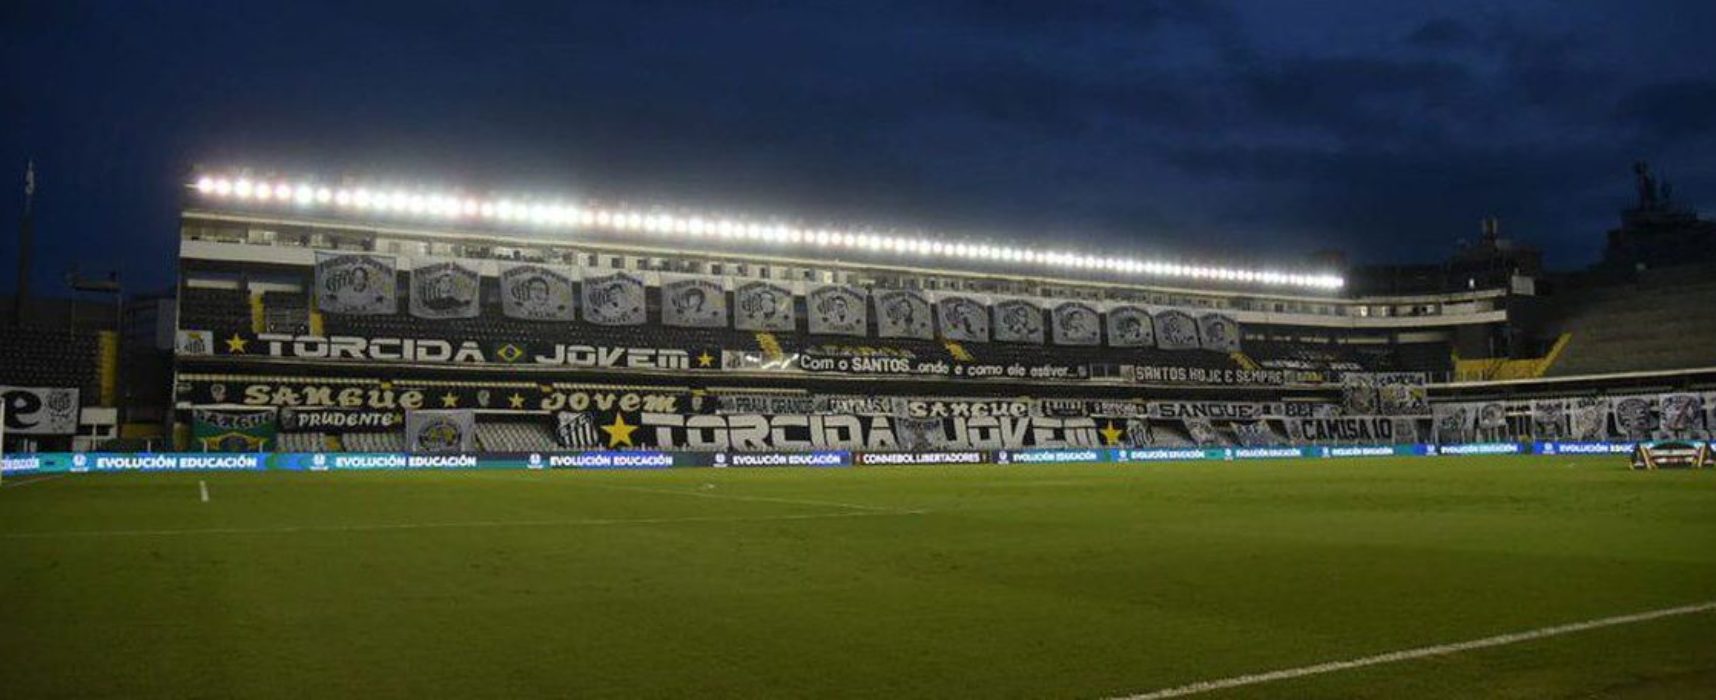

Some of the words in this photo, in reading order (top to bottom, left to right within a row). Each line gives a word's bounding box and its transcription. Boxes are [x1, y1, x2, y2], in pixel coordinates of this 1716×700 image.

[257, 333, 485, 362] TORCIDA
[801, 355, 834, 369] Com
[838, 360, 848, 370] o
[1136, 366, 1186, 380] SANTOS
[1236, 370, 1282, 383] SEMPRE
[641, 412, 906, 451] TORCIDA
[1301, 418, 1373, 440] CAMISA
[1559, 442, 1608, 453] EVOLUCIÓN
[97, 457, 176, 468] EVOLUCIÓN
[179, 456, 257, 468] EDUCACIÓN
[336, 455, 406, 467] EVOLUCIÓN
[408, 454, 476, 467] EDUCACIÓN
[550, 455, 611, 466] EVOLUCIÓN
[613, 454, 673, 466] EDUCACIÓN
[733, 453, 787, 465] EVOLUCIÓN
[789, 453, 841, 465] EDUCACIÓN
[863, 452, 914, 464] CONMEBOL
[916, 452, 980, 463] LIBERTADORES
